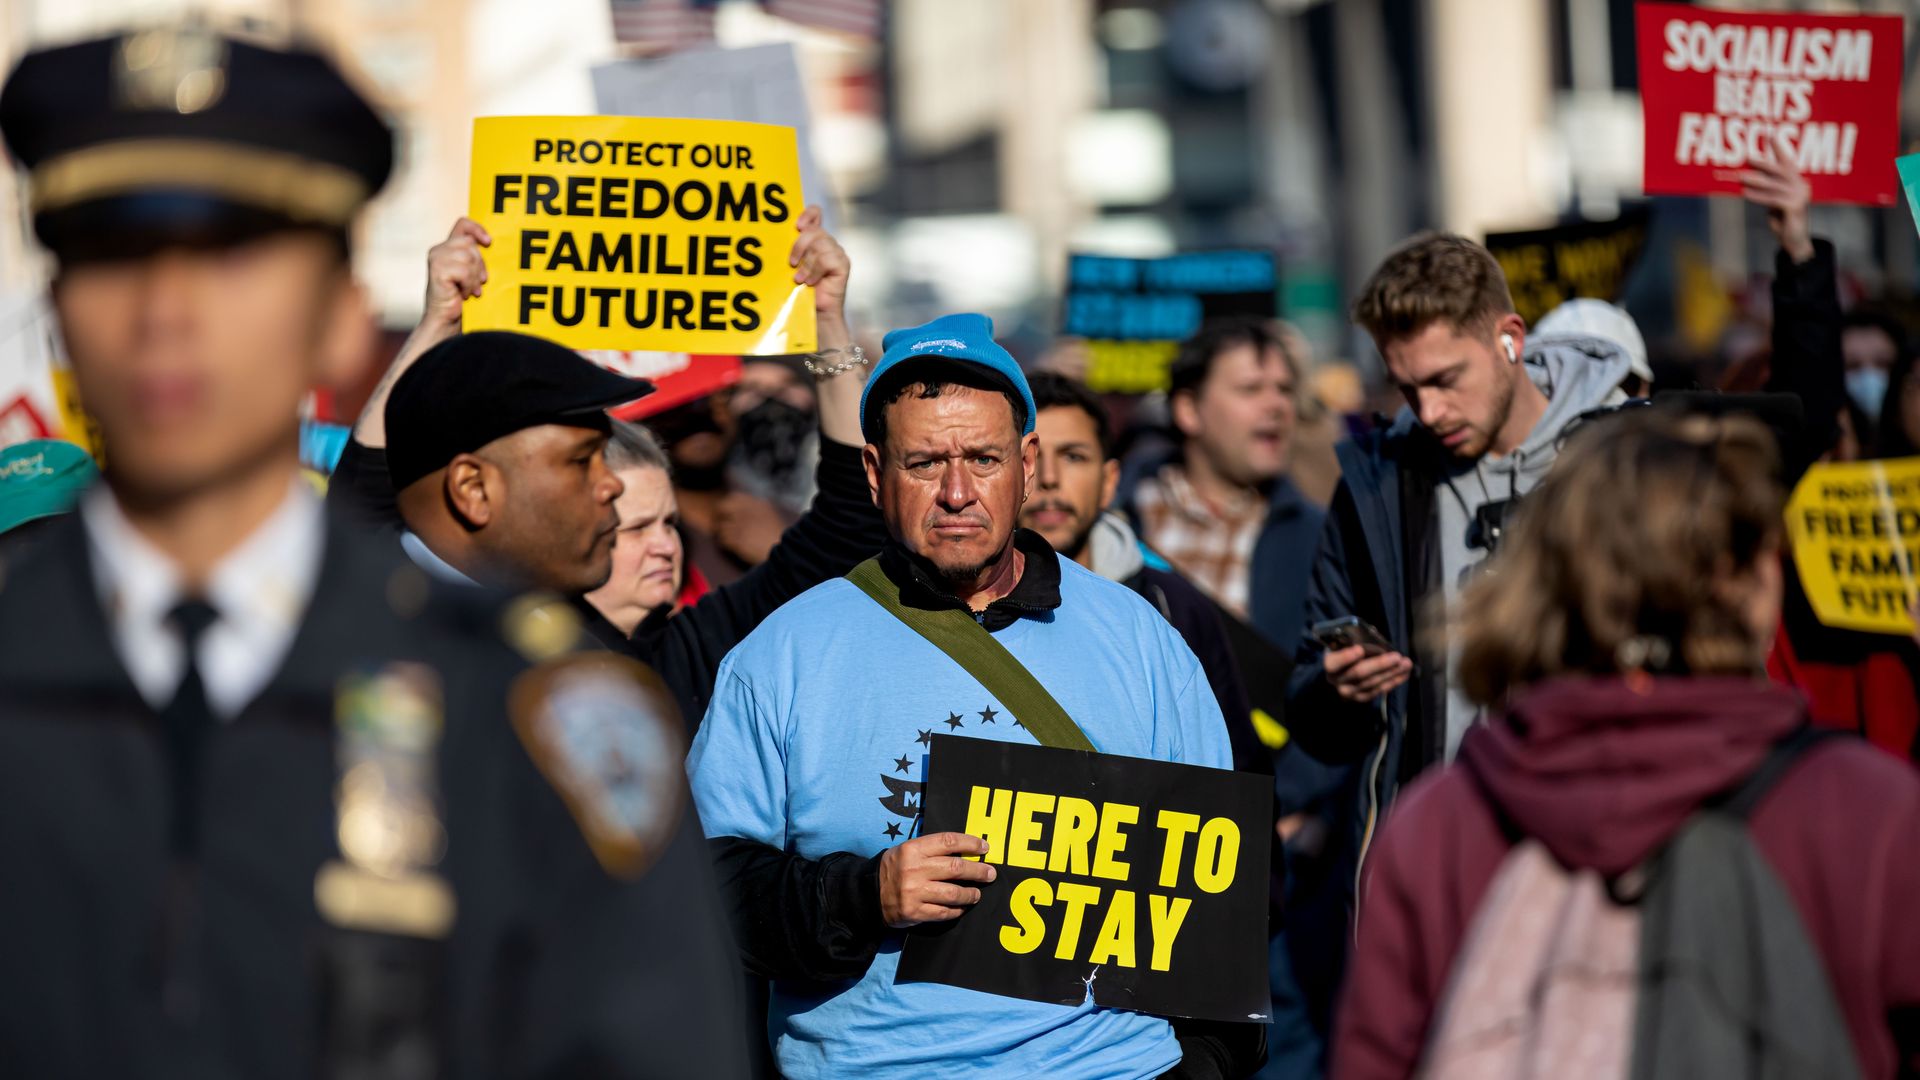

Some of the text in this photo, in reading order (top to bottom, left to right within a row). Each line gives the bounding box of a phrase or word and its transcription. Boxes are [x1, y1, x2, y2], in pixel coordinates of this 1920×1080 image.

[1663, 19, 1872, 81] SOCIALISM
[1714, 72, 1814, 121] BEATS
[534, 139, 754, 169] PROTECT OUR
[1675, 112, 1858, 175] FASCISM!
[492, 174, 789, 224] FREEDOMS
[519, 230, 763, 278] FAMILIES
[518, 285, 761, 332] FUTURES
[961, 785, 1241, 894] HERE TO
[999, 877, 1193, 972] STAY
